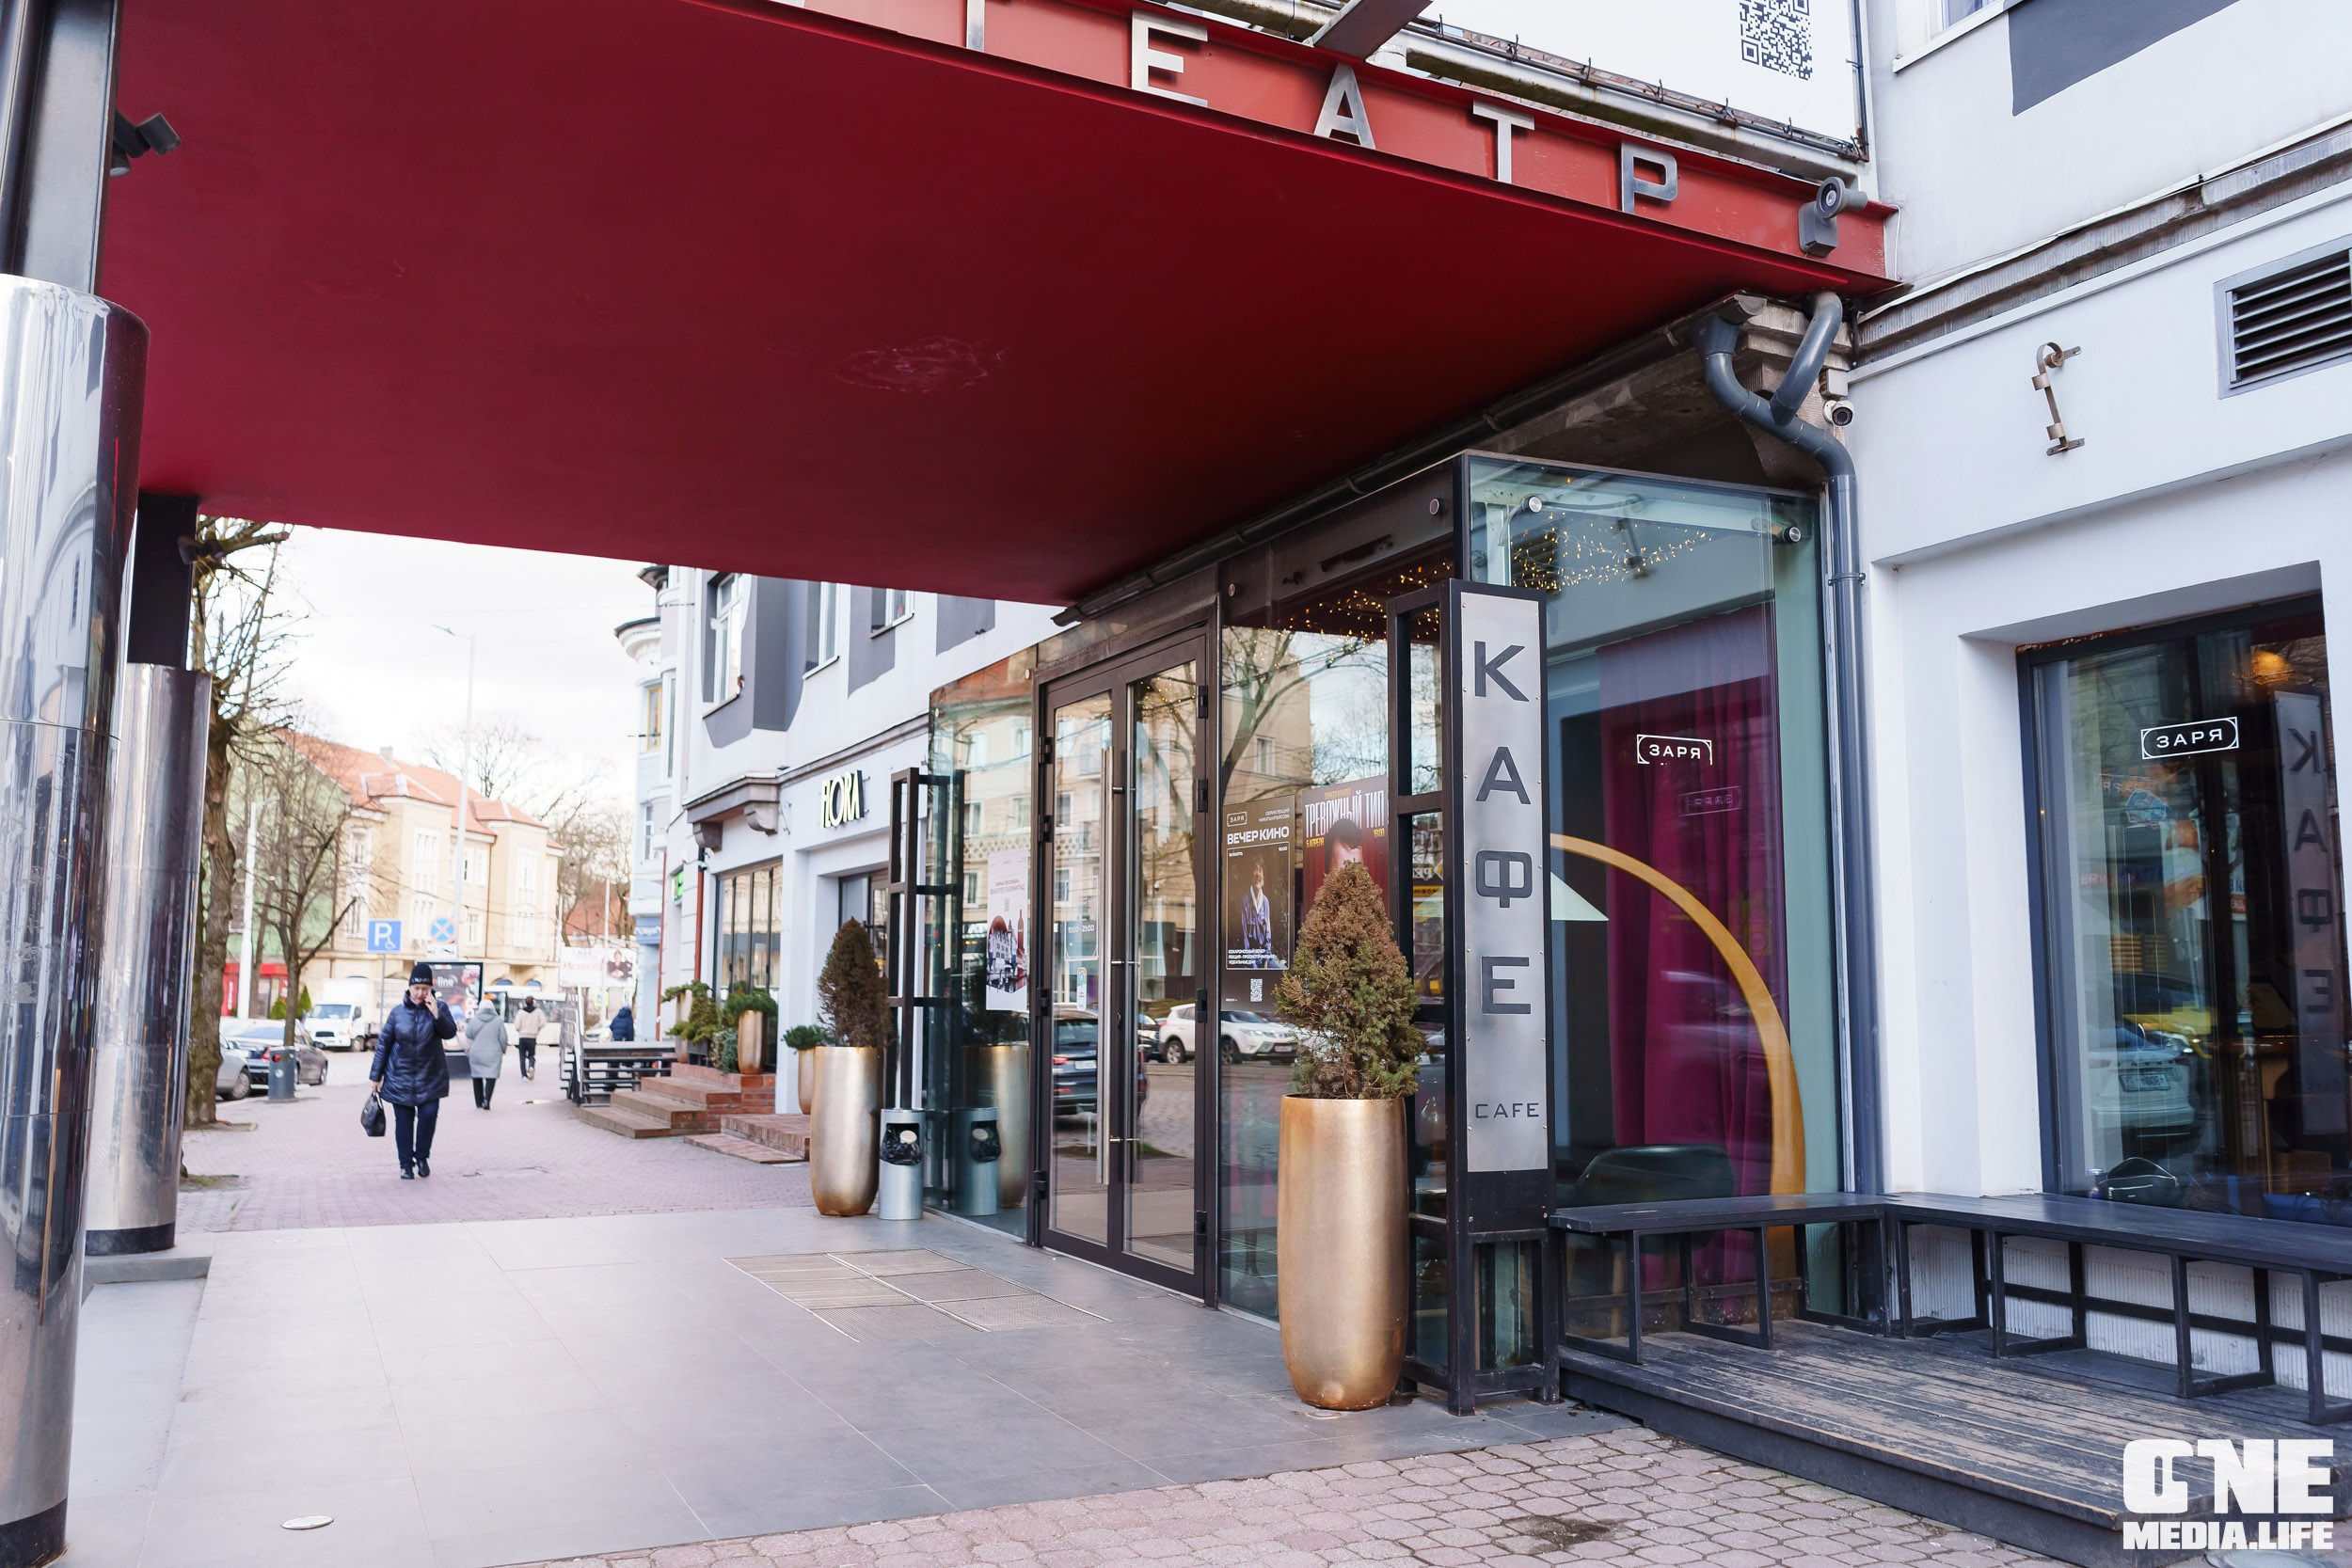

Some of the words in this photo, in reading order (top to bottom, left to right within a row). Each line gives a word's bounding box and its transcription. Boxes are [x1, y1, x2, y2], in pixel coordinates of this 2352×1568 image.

[2155, 728, 2223, 749] ЗАРЯ
[1648, 743, 1701, 760] ЗАРЯ
[1305, 790, 1362, 838] ТРЕВОЖНЫЙ
[1365, 790, 1385, 829] ТИП
[1227, 830, 1259, 845] ВЕЧЕР
[1260, 826, 1290, 841] КИНО
[1473, 641, 1533, 1015] КАФЕ
[1475, 1102, 1540, 1119] CAFE
